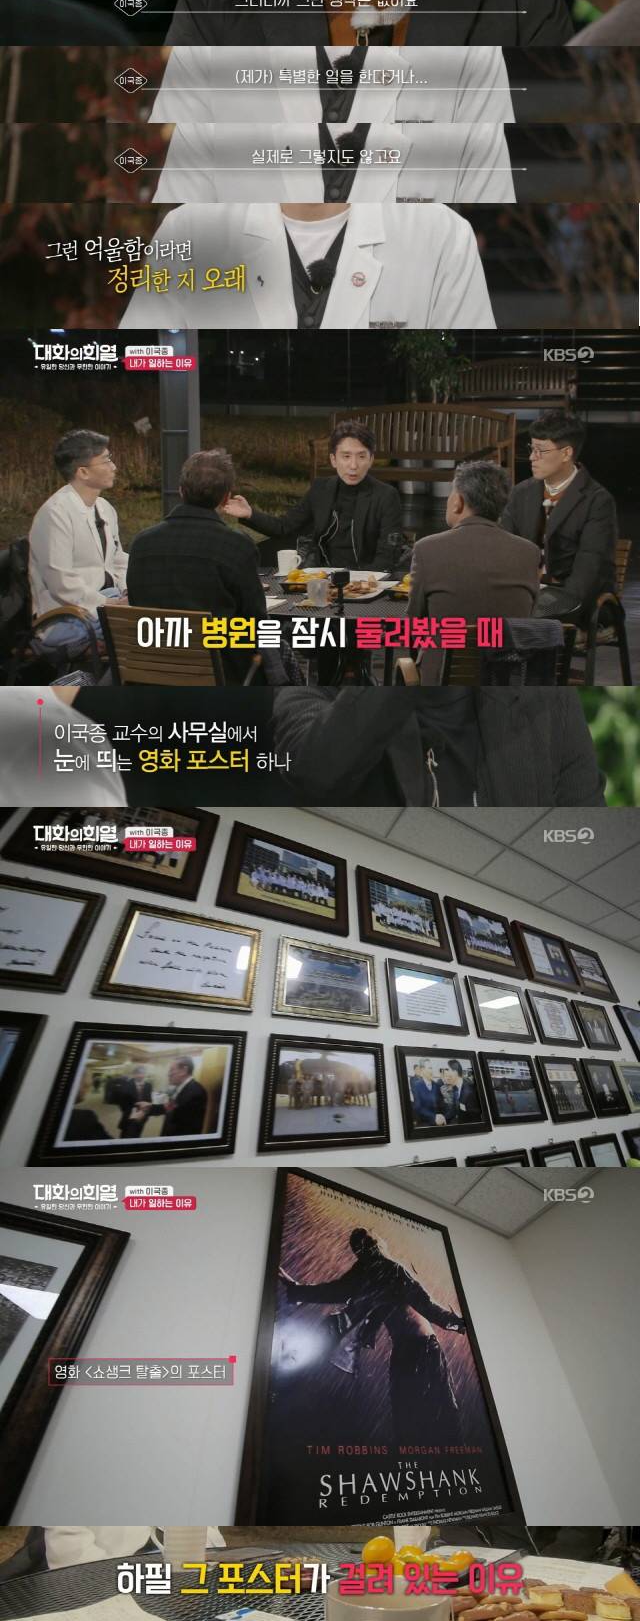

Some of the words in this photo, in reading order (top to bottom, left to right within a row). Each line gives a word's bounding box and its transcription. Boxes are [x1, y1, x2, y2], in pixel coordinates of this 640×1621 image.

[307, 1446, 331, 1454] TIM
[338, 1446, 388, 1454] ROBBINS
[400, 1446, 440, 1454] MORGAN
[445, 1446, 482, 1454] FREEMAN
[320, 1469, 480, 1497] SHAWSHANK
[319, 1486, 482, 1508] REDEMPTION
